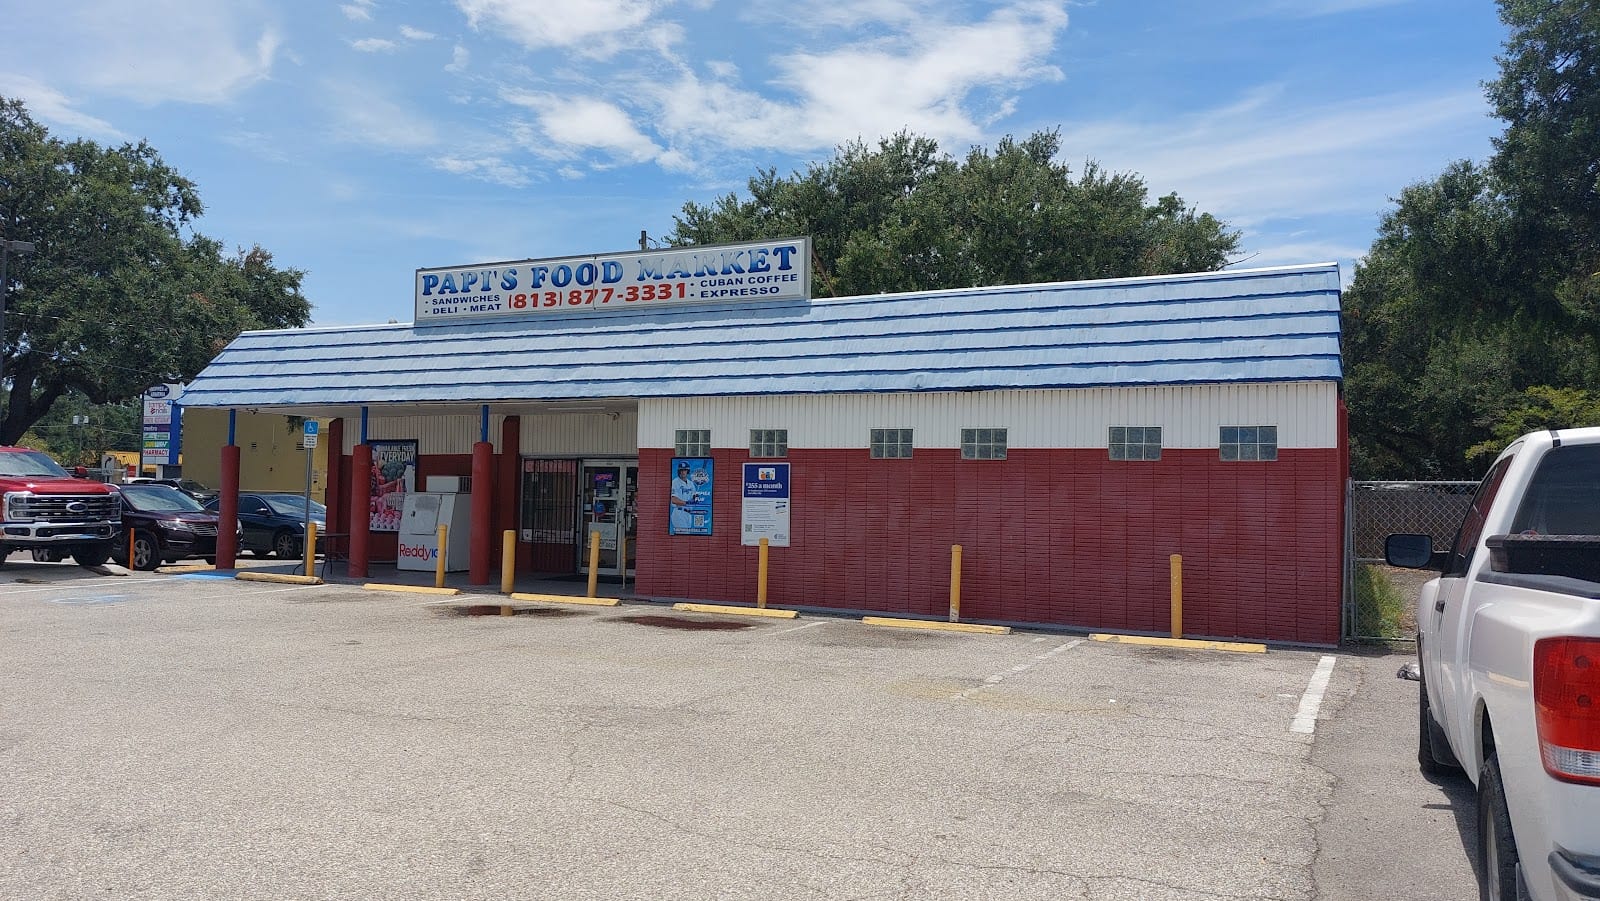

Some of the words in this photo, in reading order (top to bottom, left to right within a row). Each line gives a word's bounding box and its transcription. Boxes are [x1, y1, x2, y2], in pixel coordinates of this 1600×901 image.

[422, 268, 518, 296] PAPI'S
[531, 261, 624, 289] FOOD
[637, 246, 797, 281] MARKET
[700, 277, 744, 288] CUBAN
[747, 273, 798, 285] COFFEE
[700, 286, 780, 298] EXPRESSO
[432, 294, 500, 306] SANDWICHES
[433, 306, 458, 315] DELI
[470, 303, 502, 313] MEAT
[380, 451, 415, 462] EVERYDAY
